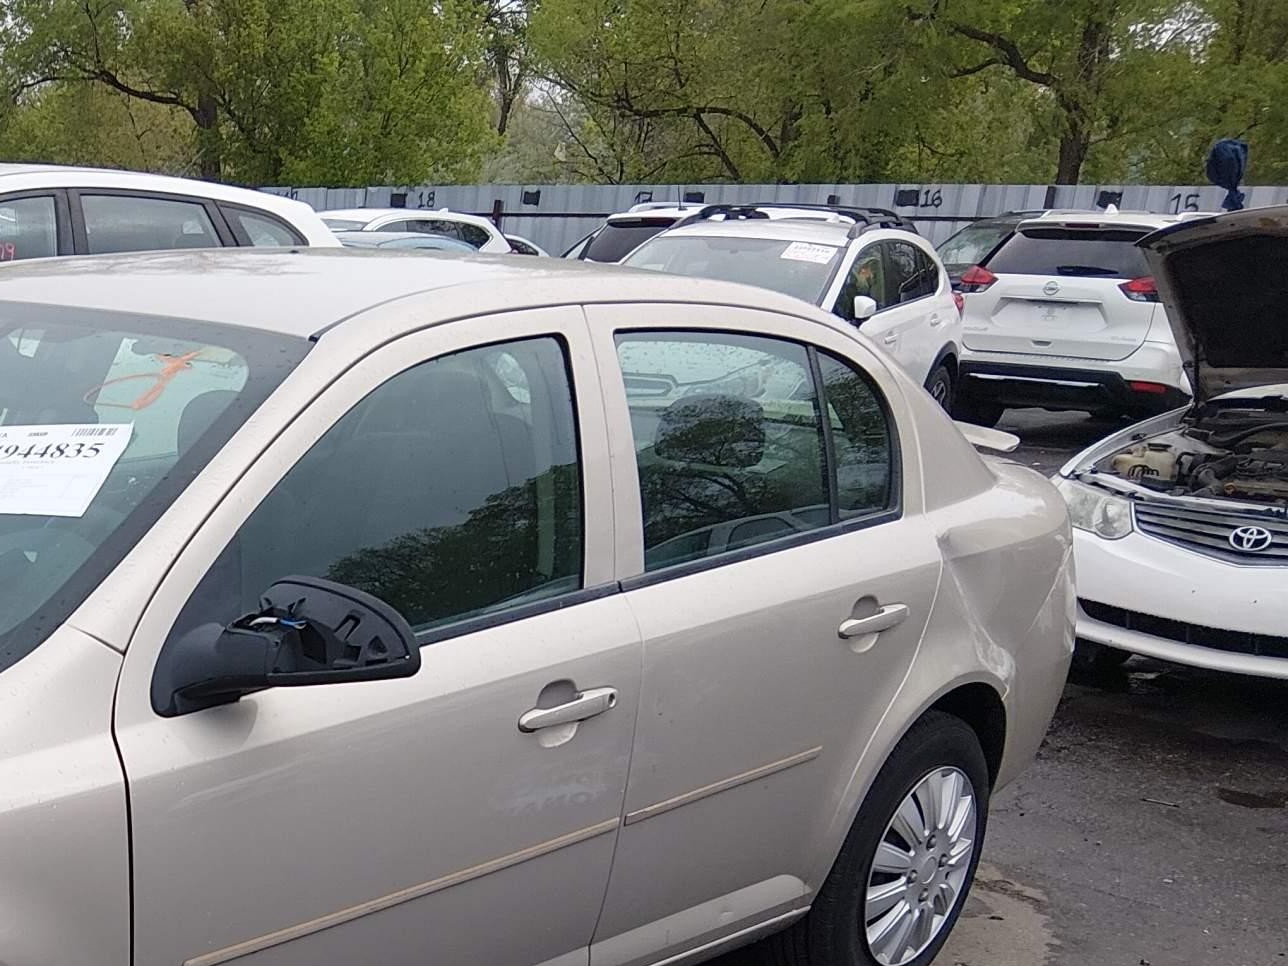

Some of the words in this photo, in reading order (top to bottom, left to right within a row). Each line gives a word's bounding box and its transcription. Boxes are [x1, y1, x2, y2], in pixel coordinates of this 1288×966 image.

[417, 190, 436, 208] 18
[920, 189, 943, 208] 16
[1170, 193, 1200, 214] 15
